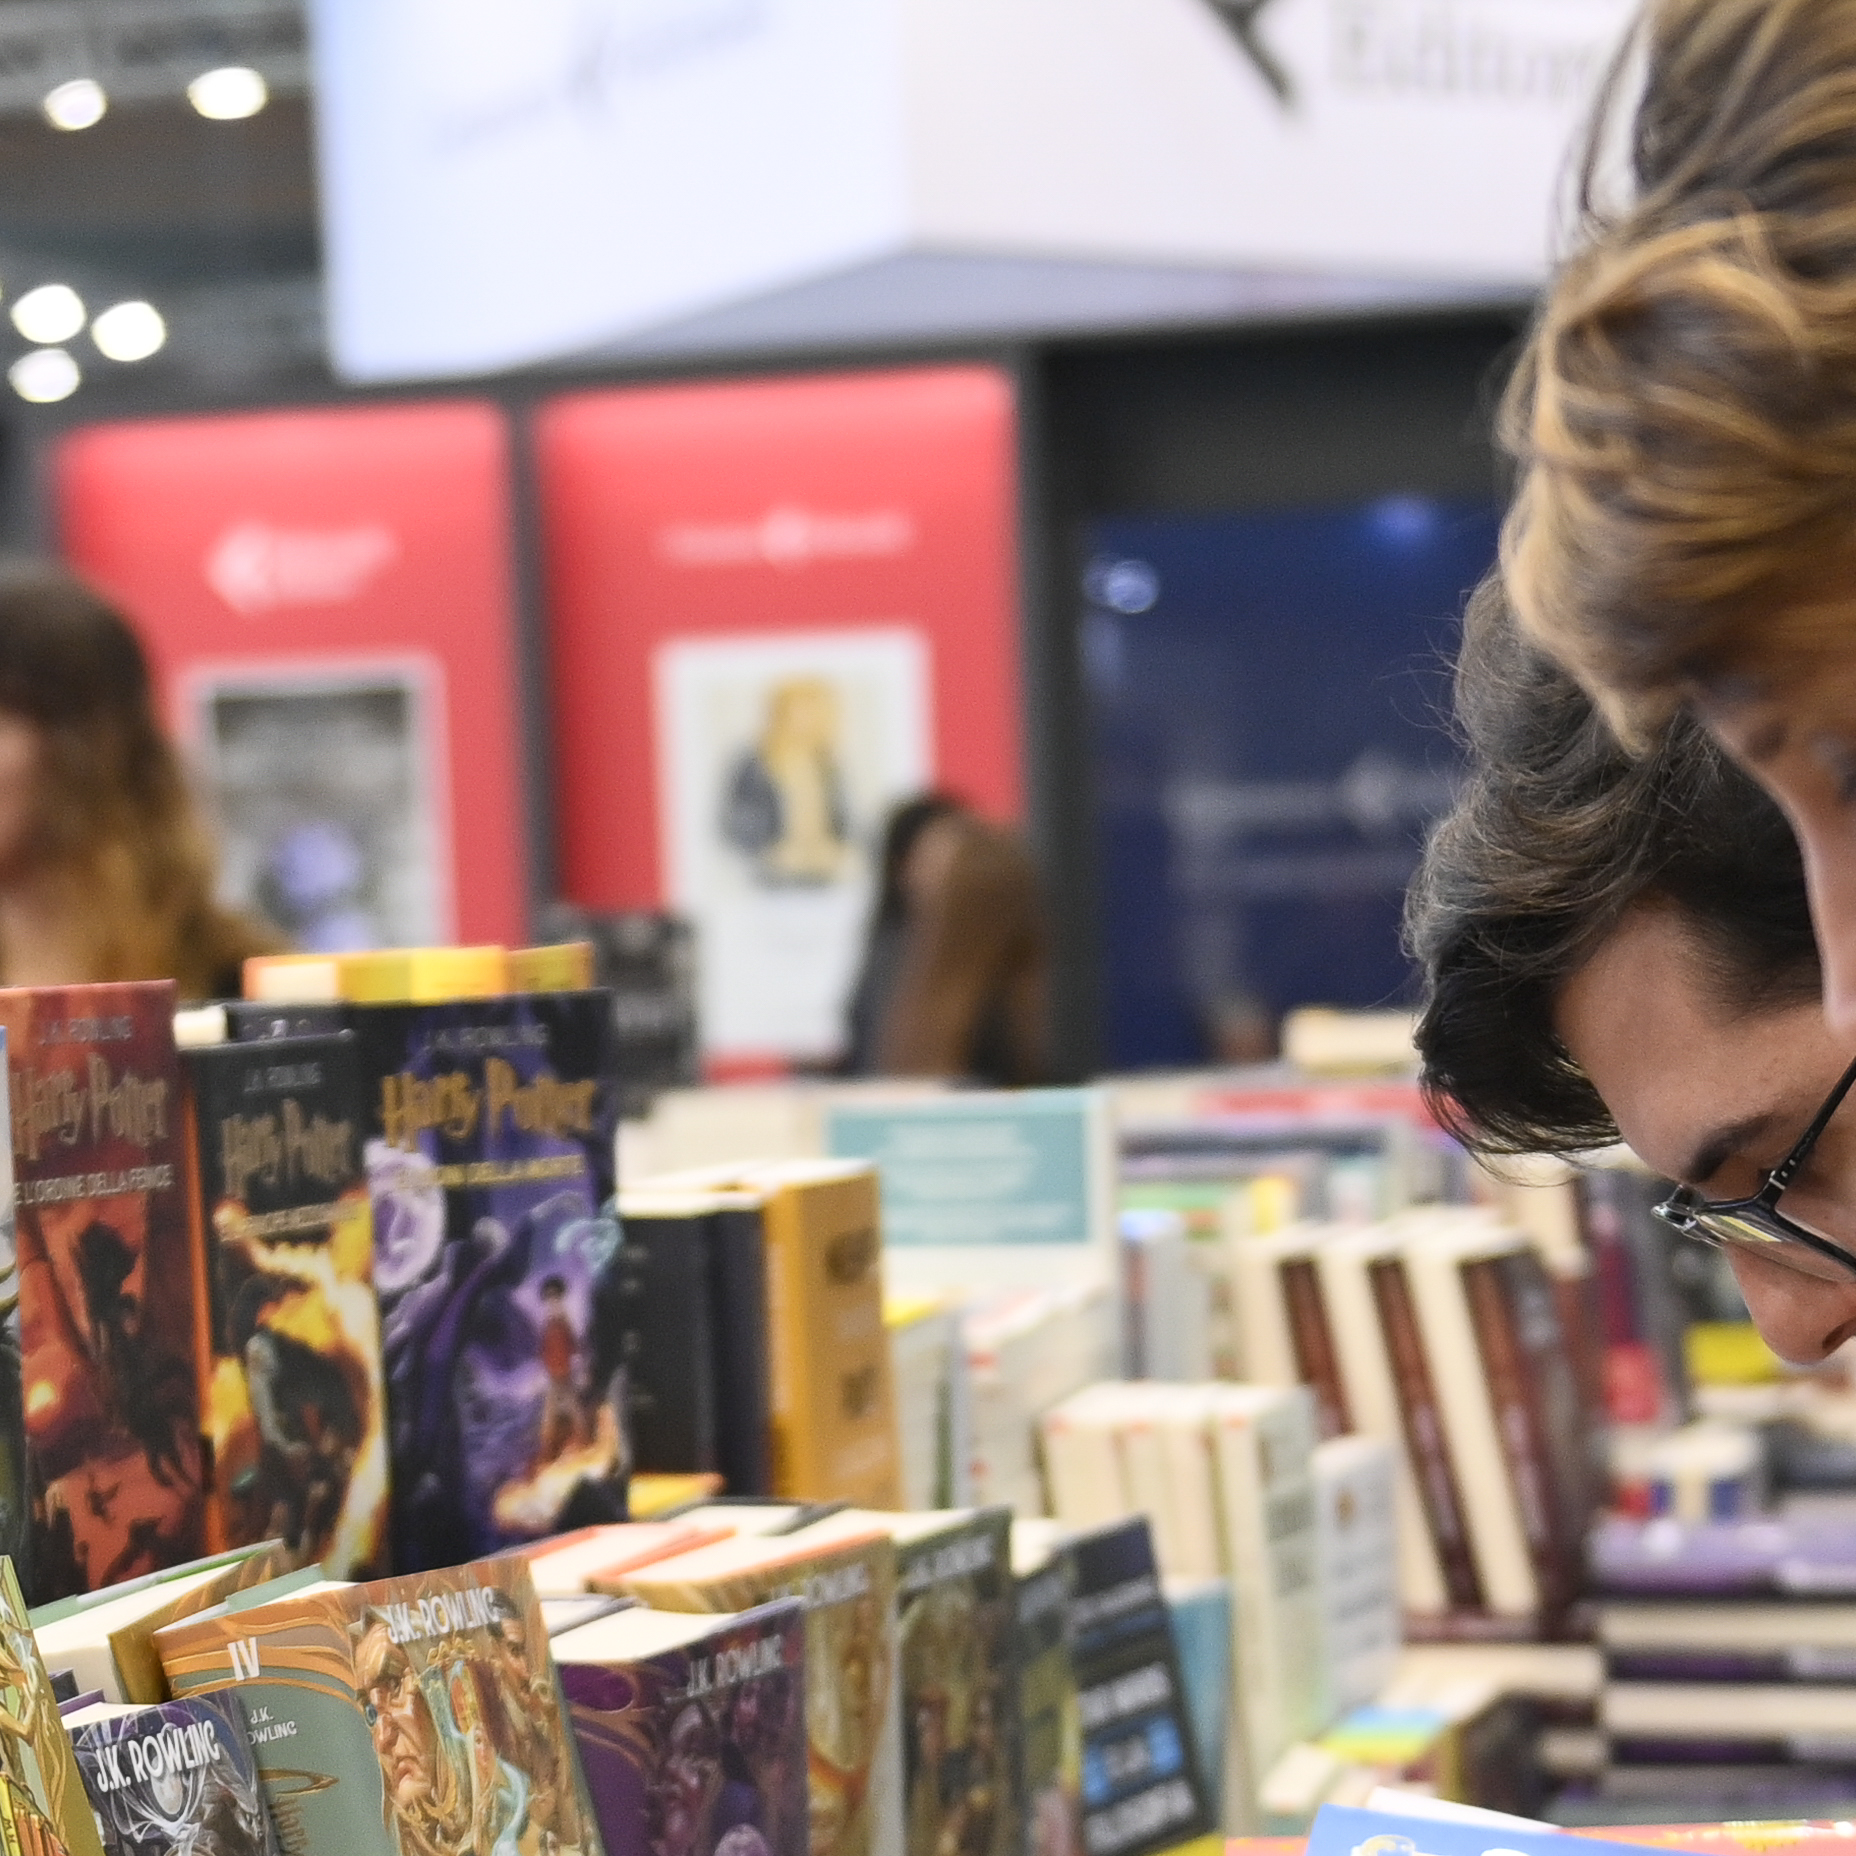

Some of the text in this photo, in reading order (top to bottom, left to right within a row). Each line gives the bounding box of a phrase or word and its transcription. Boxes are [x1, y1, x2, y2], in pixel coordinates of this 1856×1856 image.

[12, 1051, 171, 1162] Harry Potter
[380, 1057, 597, 1153] Harry Potter
[384, 1587, 501, 1646] J.K. ROWLING
[227, 1636, 261, 1682] IV
[713, 1636, 784, 1688] ROWLING
[249, 1706, 275, 1725] J.K.
[96, 1719, 221, 1793] J.K. ROWLING
